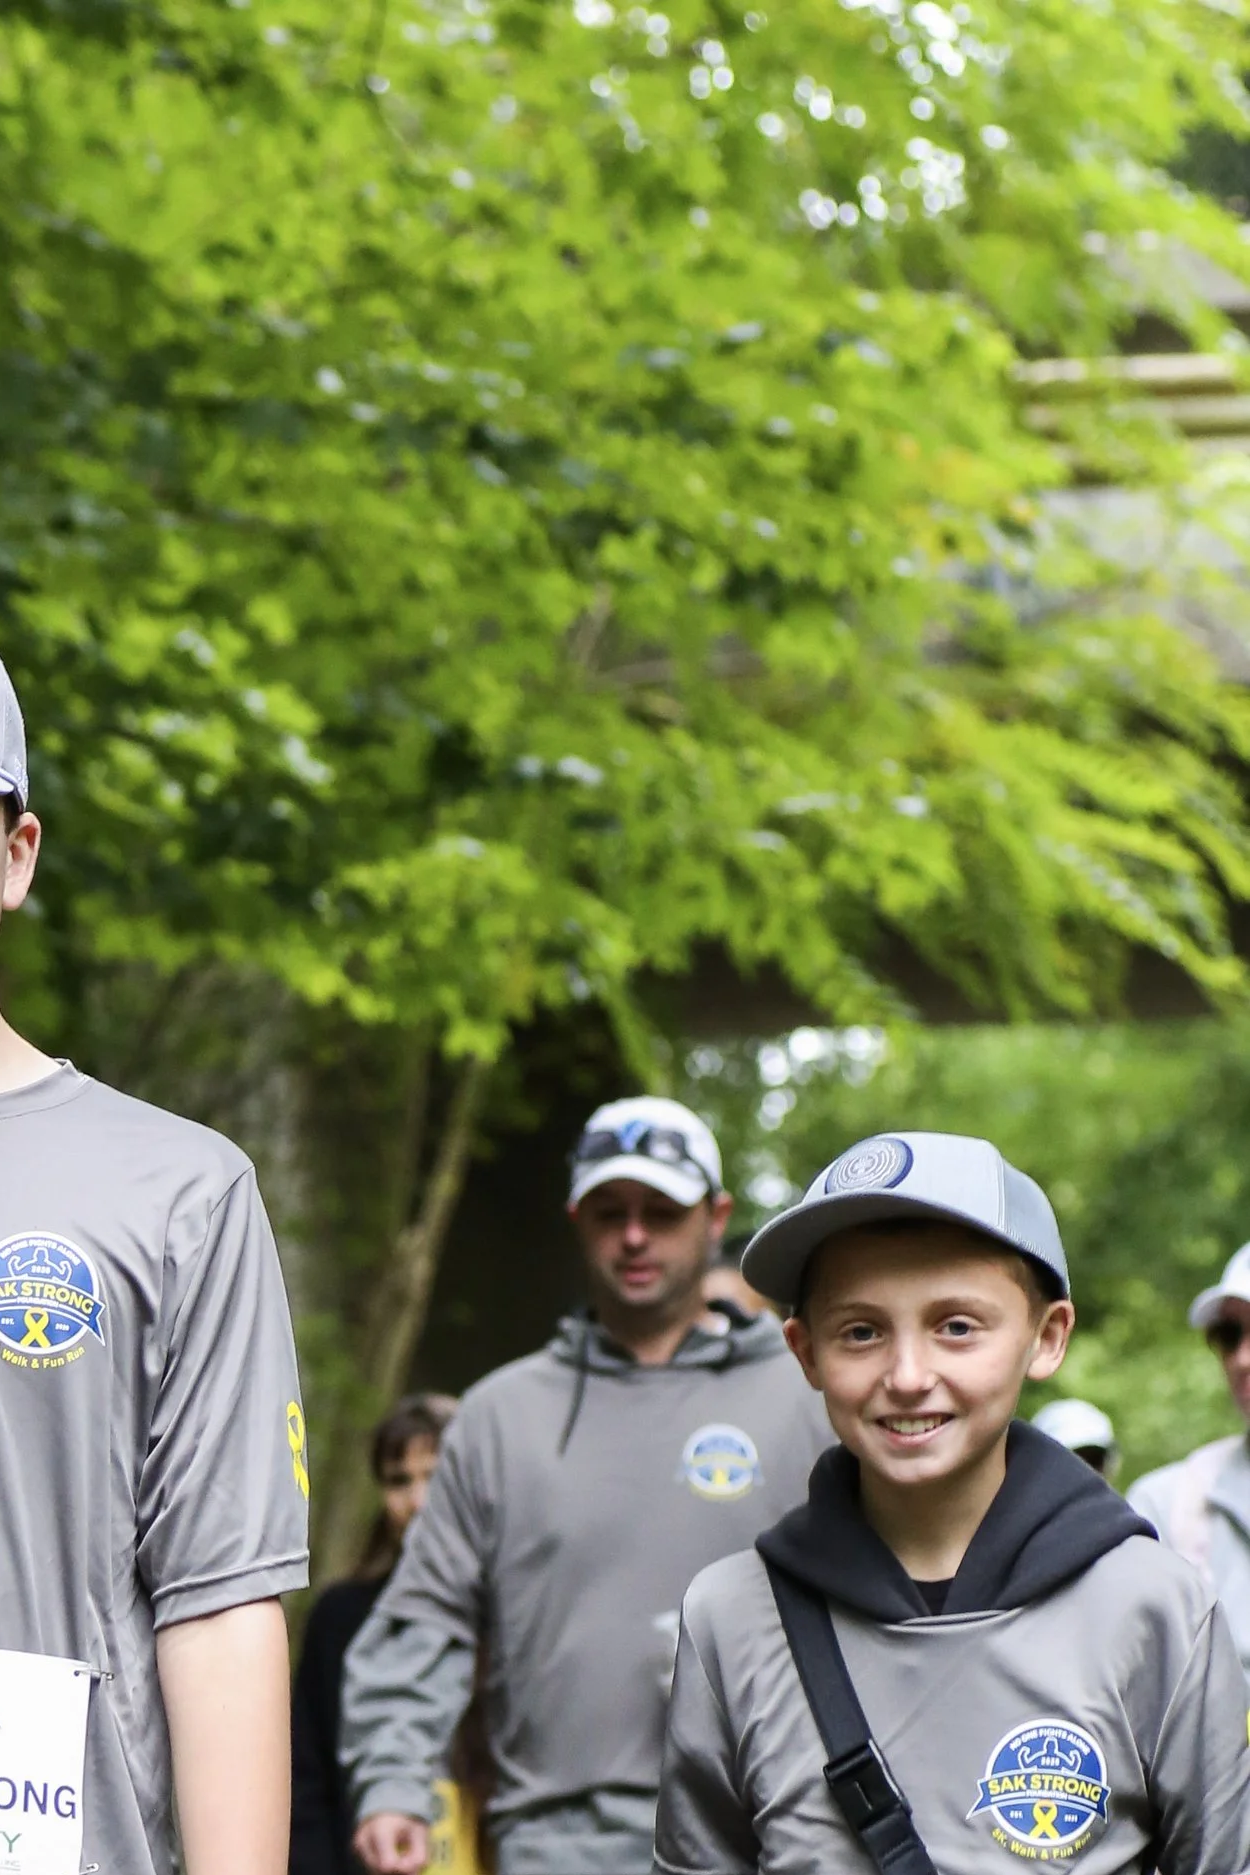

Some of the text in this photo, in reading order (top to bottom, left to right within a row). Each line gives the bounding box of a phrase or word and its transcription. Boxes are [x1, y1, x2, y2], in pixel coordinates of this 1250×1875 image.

[21, 1281, 94, 1315] STRONG
[1, 1349, 28, 1368] Walk
[31, 1358, 40, 1369] &
[43, 1357, 65, 1369] Fun
[66, 1346, 86, 1362] Run
[988, 1774, 1102, 1801] SAK STRONG
[1011, 1841, 1037, 1859] Walk
[1052, 1846, 1074, 1860] Fun
